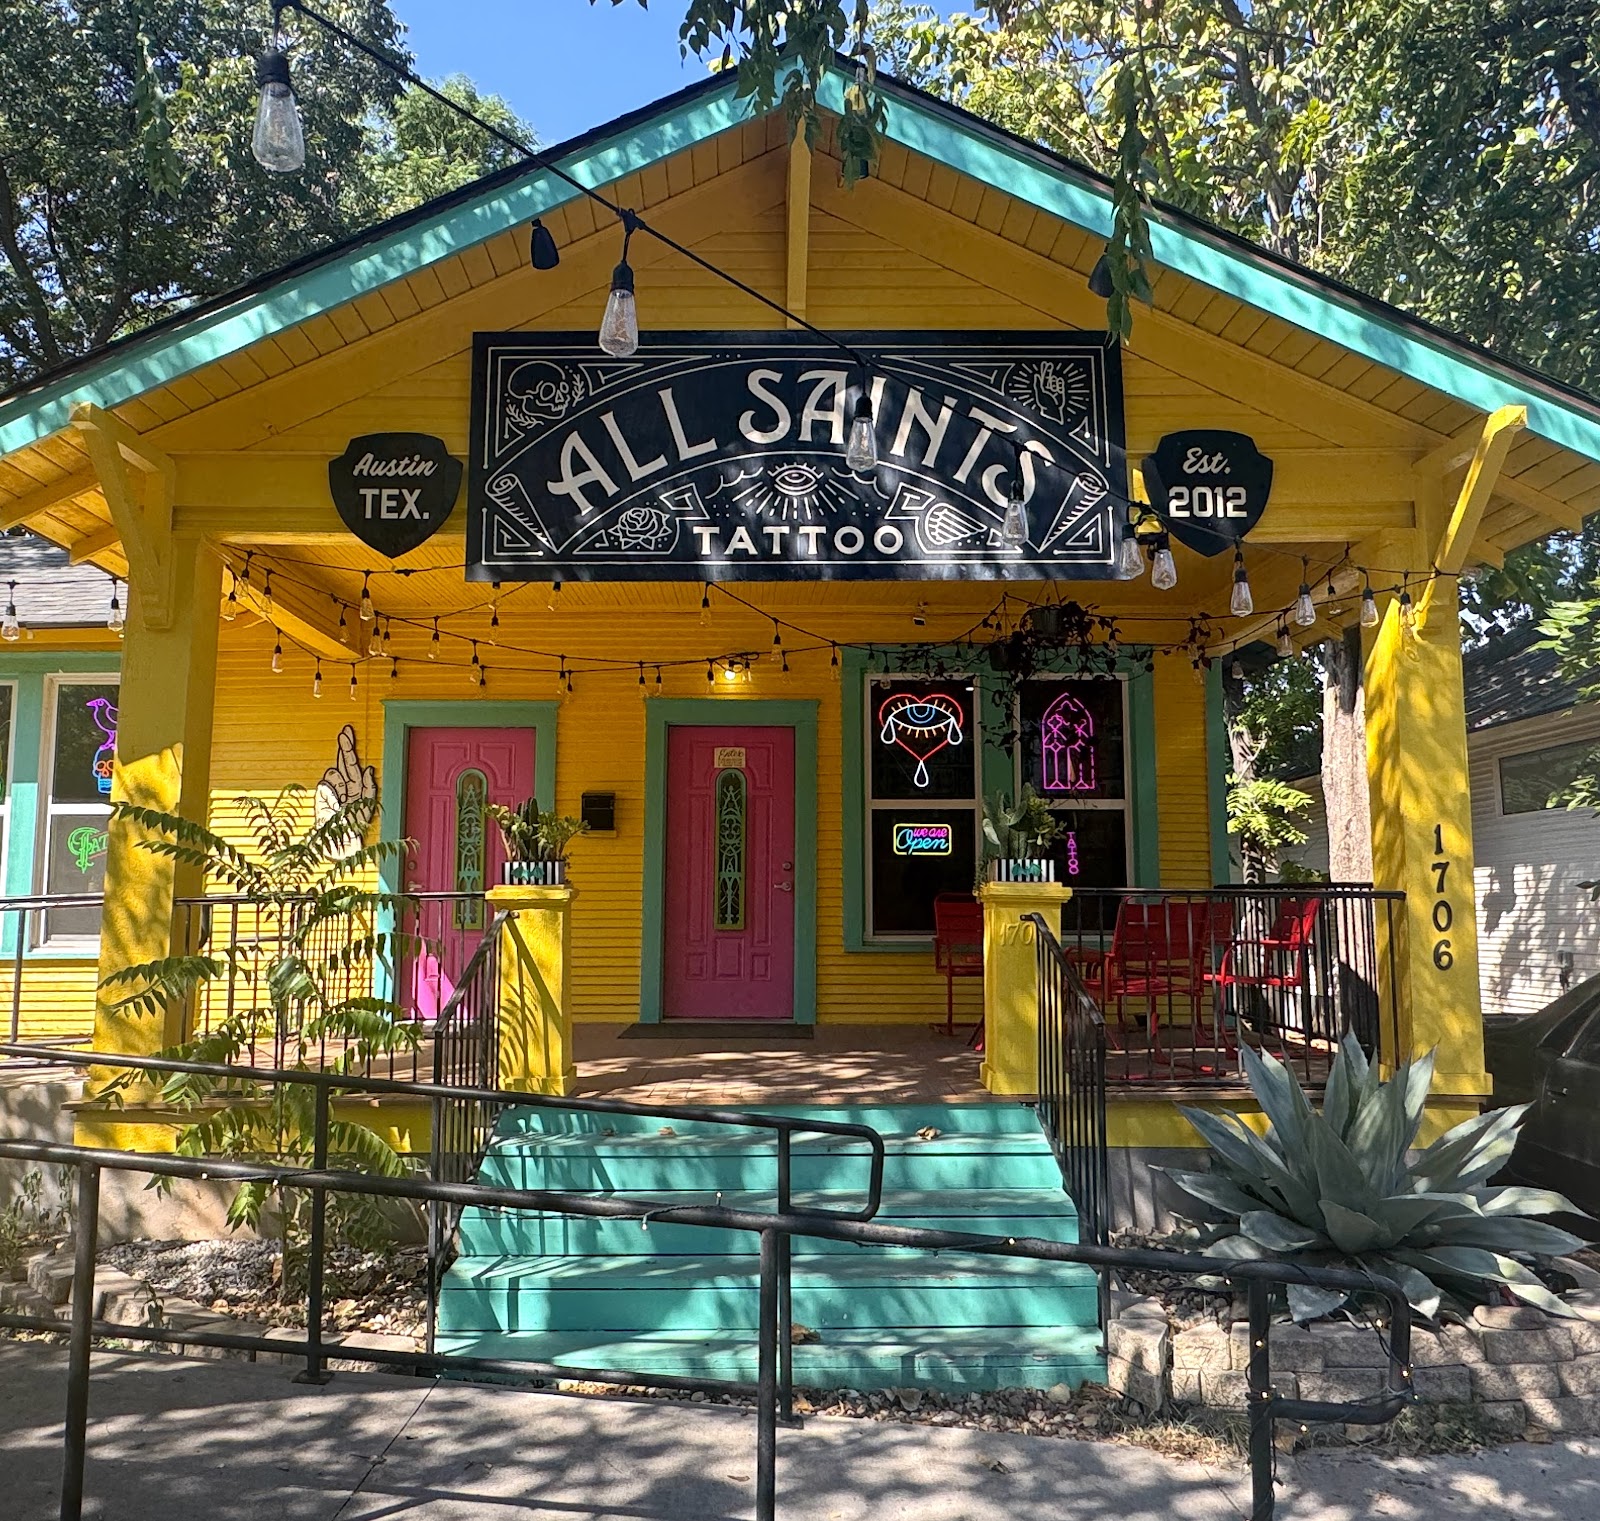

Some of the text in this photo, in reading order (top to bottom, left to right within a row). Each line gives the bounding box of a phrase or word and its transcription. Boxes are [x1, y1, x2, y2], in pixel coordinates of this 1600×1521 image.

[352, 452, 439, 477] Austin
[547, 387, 718, 516] ALL
[1182, 447, 1231, 474] Est.
[358, 488, 430, 519] TEX.
[1168, 486, 1248, 518] 2012
[692, 526, 904, 555] TATTOO
[896, 828, 949, 855] Open
[928, 827, 948, 838] are
[1431, 824, 1453, 971] 1706
[999, 921, 1036, 946] 170
